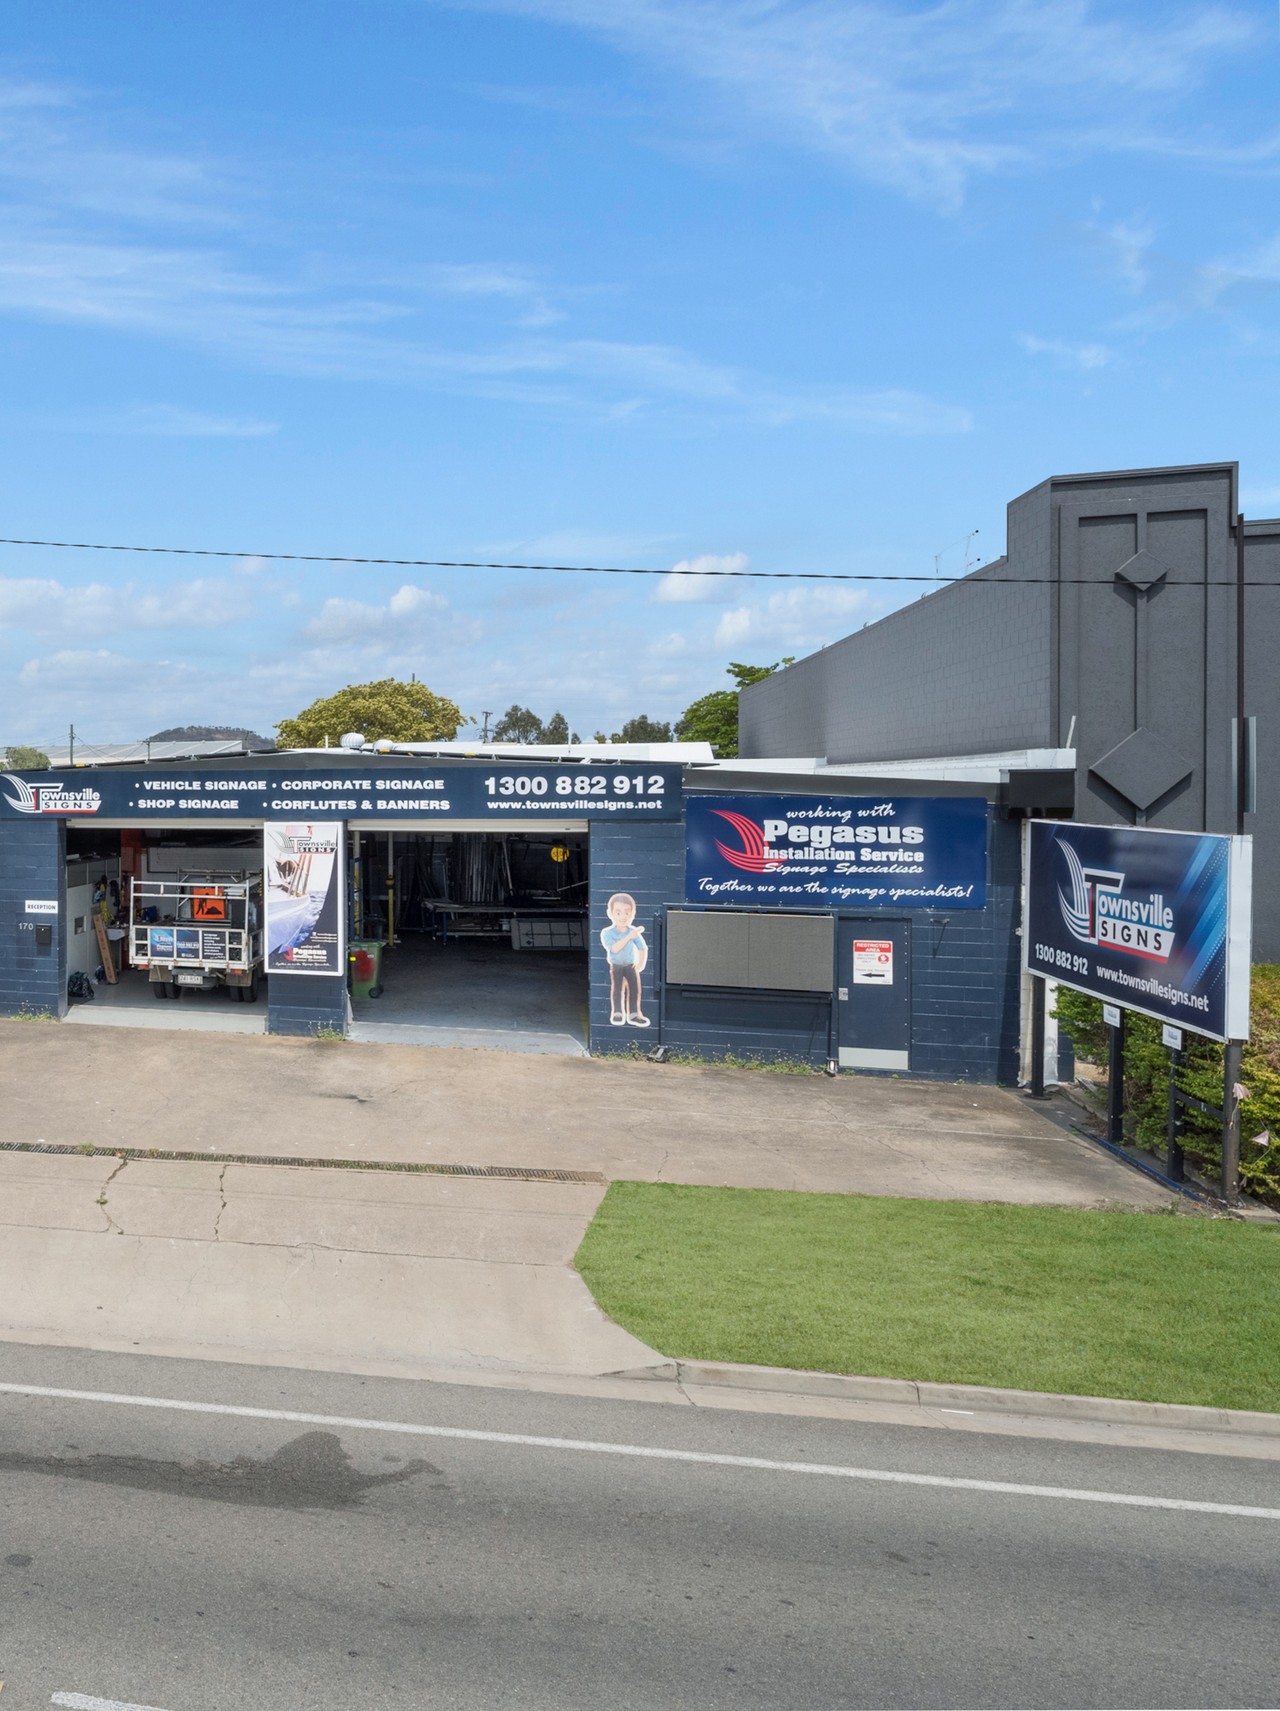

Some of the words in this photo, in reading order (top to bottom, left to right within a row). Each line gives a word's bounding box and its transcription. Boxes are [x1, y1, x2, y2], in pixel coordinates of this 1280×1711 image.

[144, 781, 201, 791] VEHICLE
[204, 781, 267, 791] SIGNAGE
[281, 780, 371, 790] CORPORATE
[375, 780, 445, 790] SIGNAGE
[485, 777, 548, 795] 1300
[555, 776, 606, 795] 882
[613, 775, 665, 795] 912
[27, 783, 100, 813] Townsville
[44, 802, 93, 810] SIGNS
[138, 800, 175, 809] SHOP
[178, 800, 239, 810] SIGNAGE
[271, 800, 358, 810] CORFLUTES
[360, 800, 373, 810] &
[377, 800, 450, 810] BANNERS
[487, 800, 662, 811] www.townsvillesigns.net
[786, 806, 852, 822] working
[858, 803, 895, 817] with
[763, 820, 924, 848] Pegasus
[288, 836, 336, 853] Townsville
[763, 847, 855, 861] Installation
[860, 848, 924, 862] Service
[763, 863, 827, 875] Signage
[834, 862, 924, 875] Specialists
[698, 877, 753, 895] Together
[779, 885, 803, 893] are
[804, 881, 827, 894] the
[830, 885, 887, 899] signage
[888, 885, 974, 900] specialists!
[1082, 867, 1174, 945] Townsville
[1101, 920, 1162, 951] SIGNS
[1035, 943, 1054, 964] 1300
[1055, 950, 1072, 970] 882
[1073, 955, 1088, 975] 912
[1096, 965, 1209, 1012] www.townsvillesigns.net
